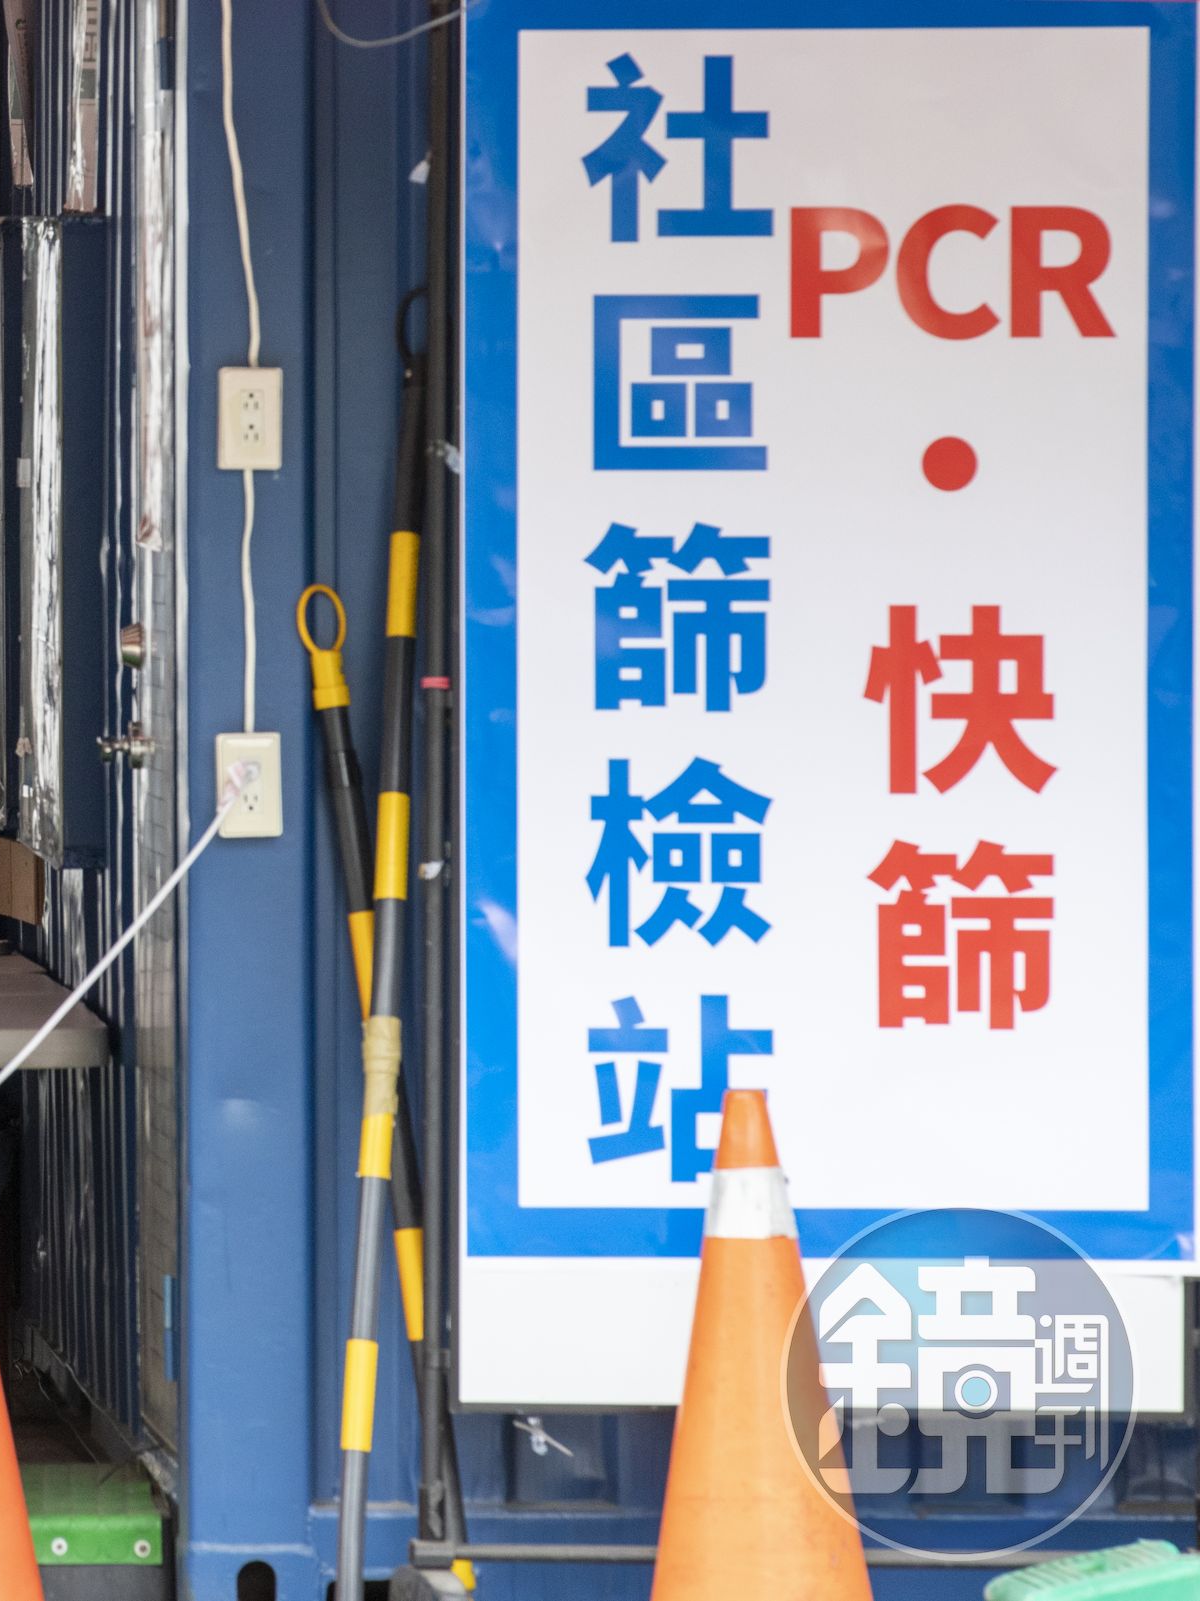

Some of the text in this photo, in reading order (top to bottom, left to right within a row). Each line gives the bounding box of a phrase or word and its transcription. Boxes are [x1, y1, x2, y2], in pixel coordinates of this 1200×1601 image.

[790, 204, 1117, 340] PCR
[581, 52, 774, 1182] 社區篩檢站
[863, 605, 1059, 1030] 快篩
